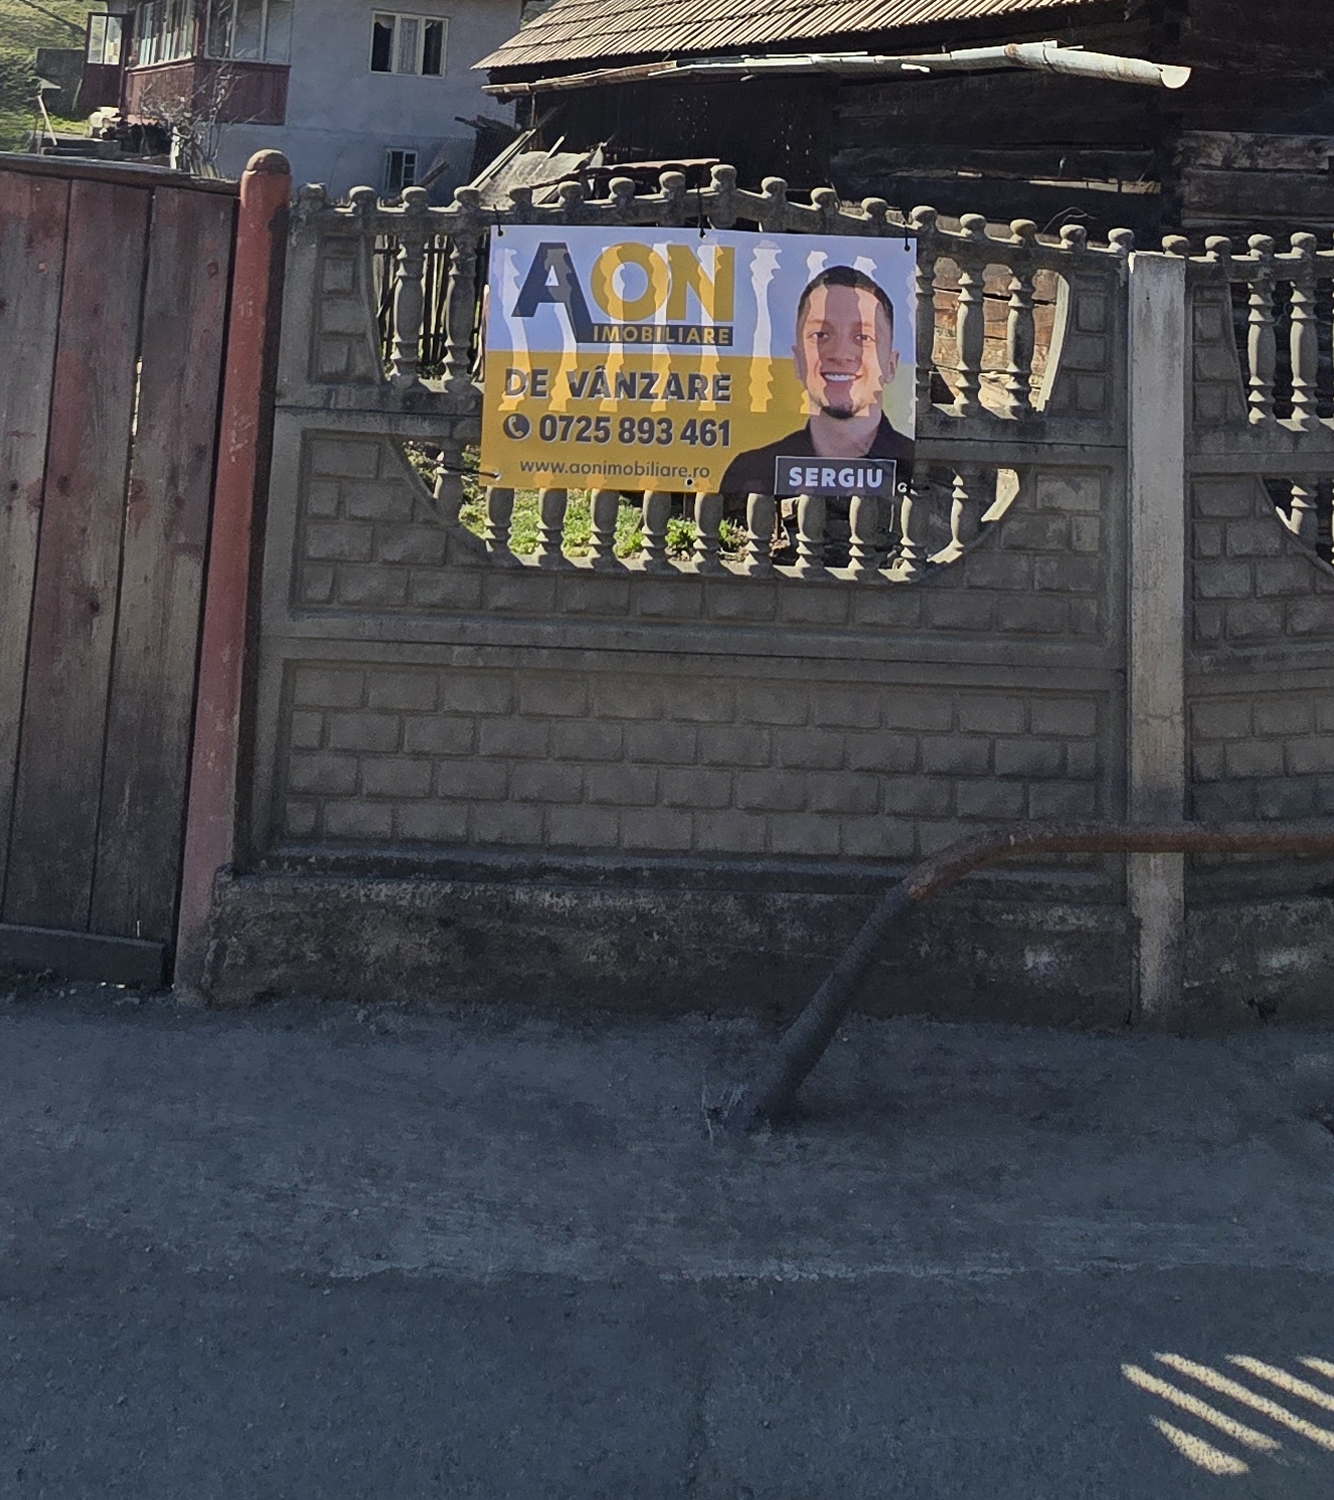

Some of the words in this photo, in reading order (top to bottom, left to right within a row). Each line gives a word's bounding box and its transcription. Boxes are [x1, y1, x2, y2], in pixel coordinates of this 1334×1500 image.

[511, 241, 735, 323] AON
[593, 325, 730, 344] IMOBILIARE
[505, 368, 549, 398] DE
[565, 365, 732, 402] VÂNZARE
[539, 413, 611, 444] 0725
[618, 416, 673, 445] 893
[680, 418, 730, 447] 461
[519, 459, 710, 479] www.aonimobiliare.ro
[788, 466, 883, 489] SERGIU
